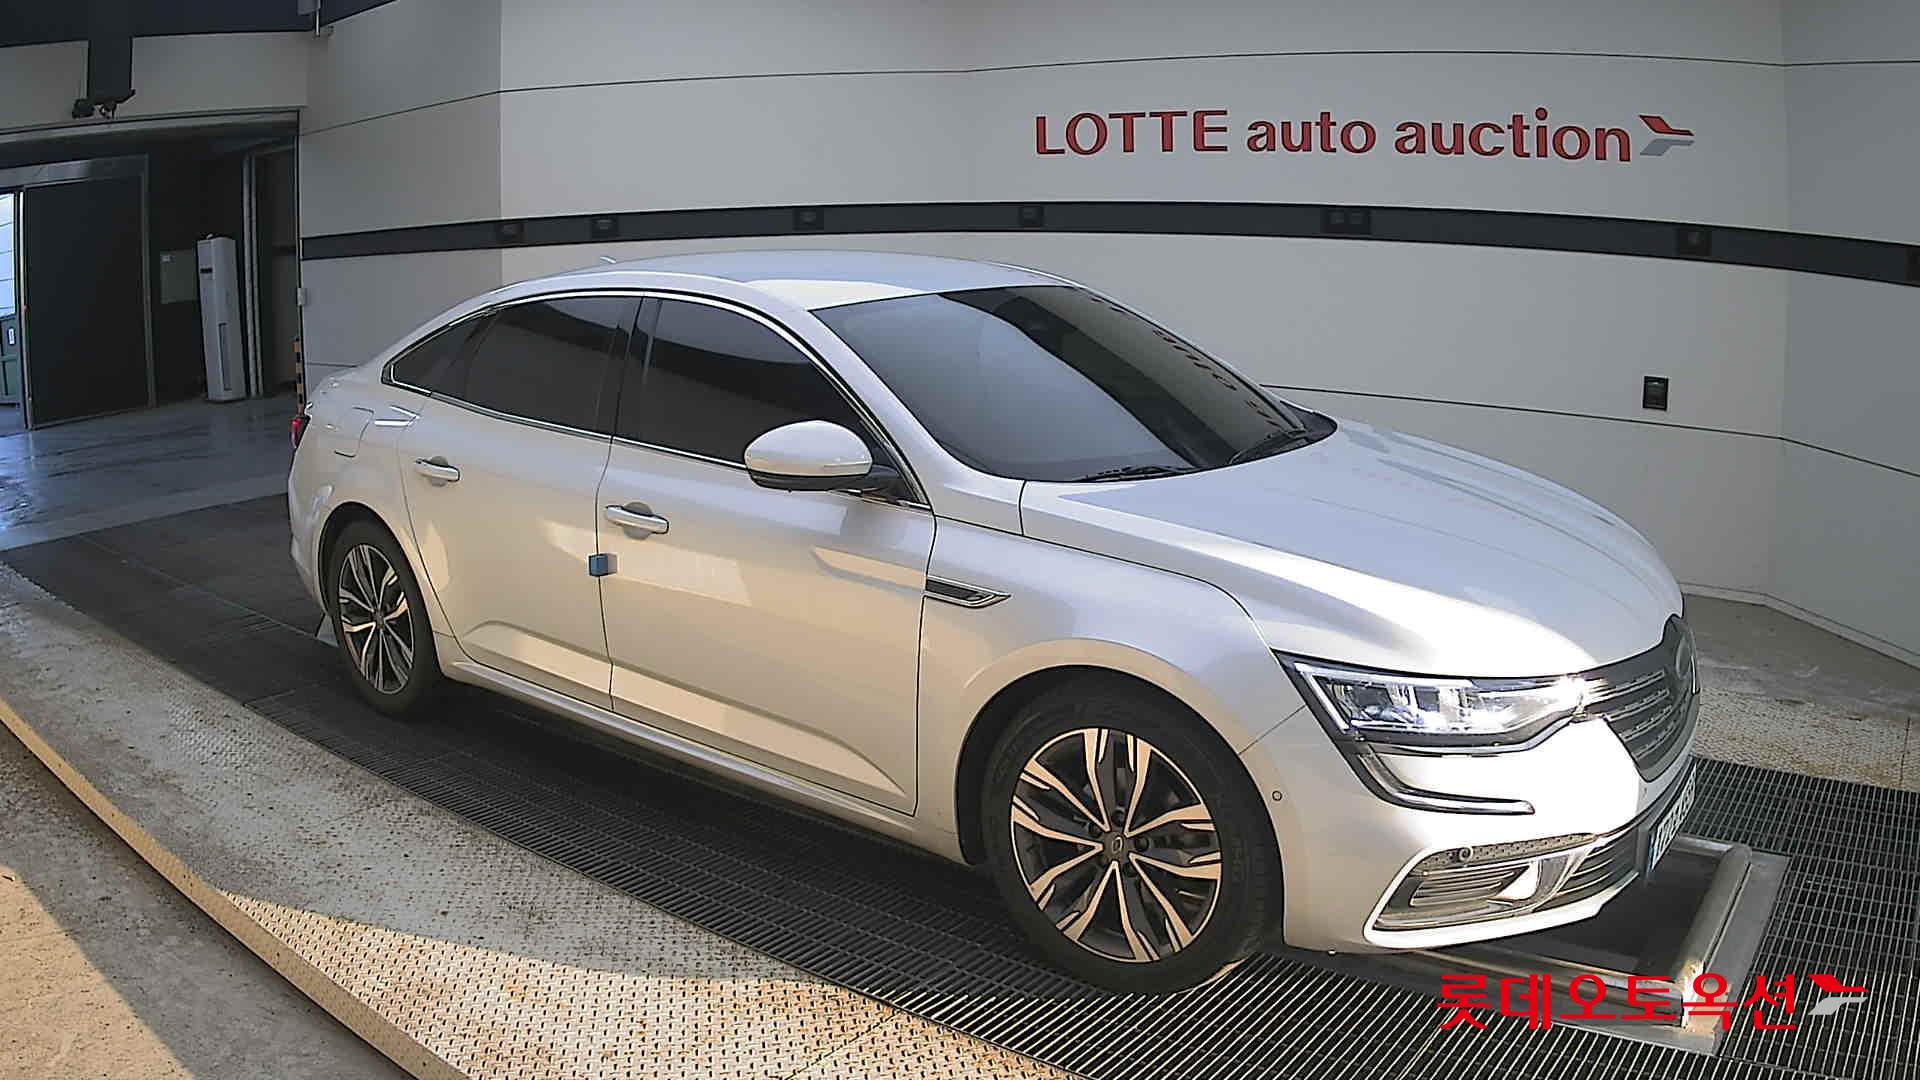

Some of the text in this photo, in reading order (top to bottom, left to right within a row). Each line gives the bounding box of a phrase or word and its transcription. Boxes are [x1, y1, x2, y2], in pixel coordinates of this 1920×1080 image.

[1036, 107, 1631, 162] LOTTE auto auction
